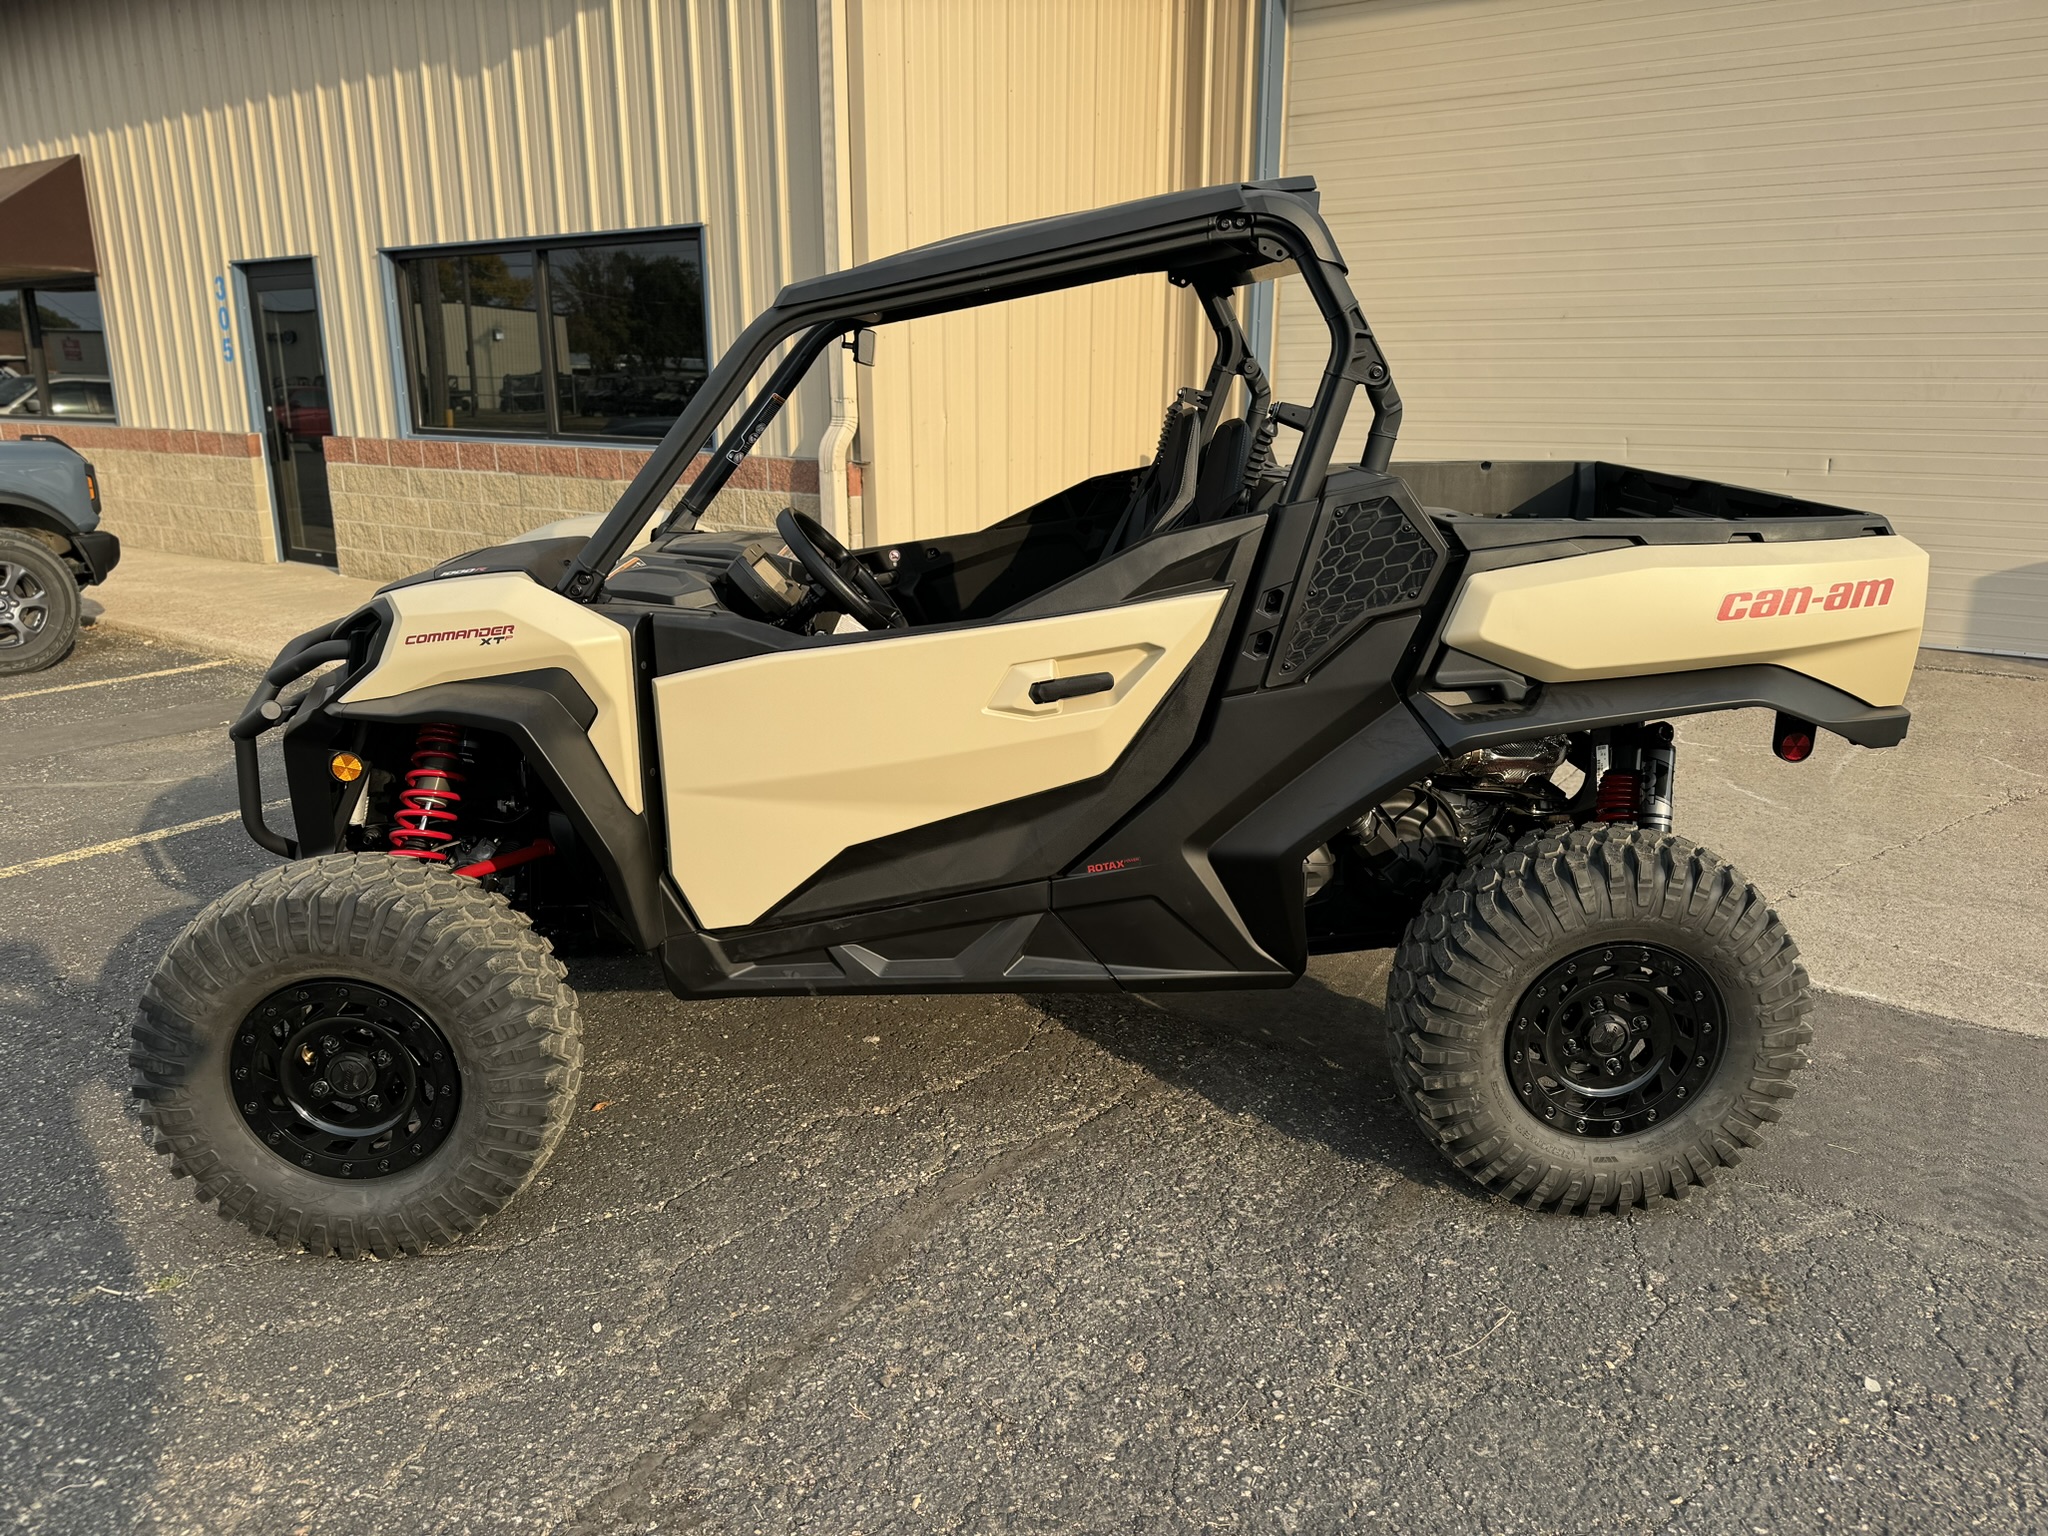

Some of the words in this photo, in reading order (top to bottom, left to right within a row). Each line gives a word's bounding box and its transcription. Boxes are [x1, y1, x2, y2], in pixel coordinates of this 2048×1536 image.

[214, 274, 234, 363] 305
[1716, 577, 1895, 622] can-am
[404, 624, 515, 645] COMMANDER
[1087, 859, 1125, 874] ROTAX
